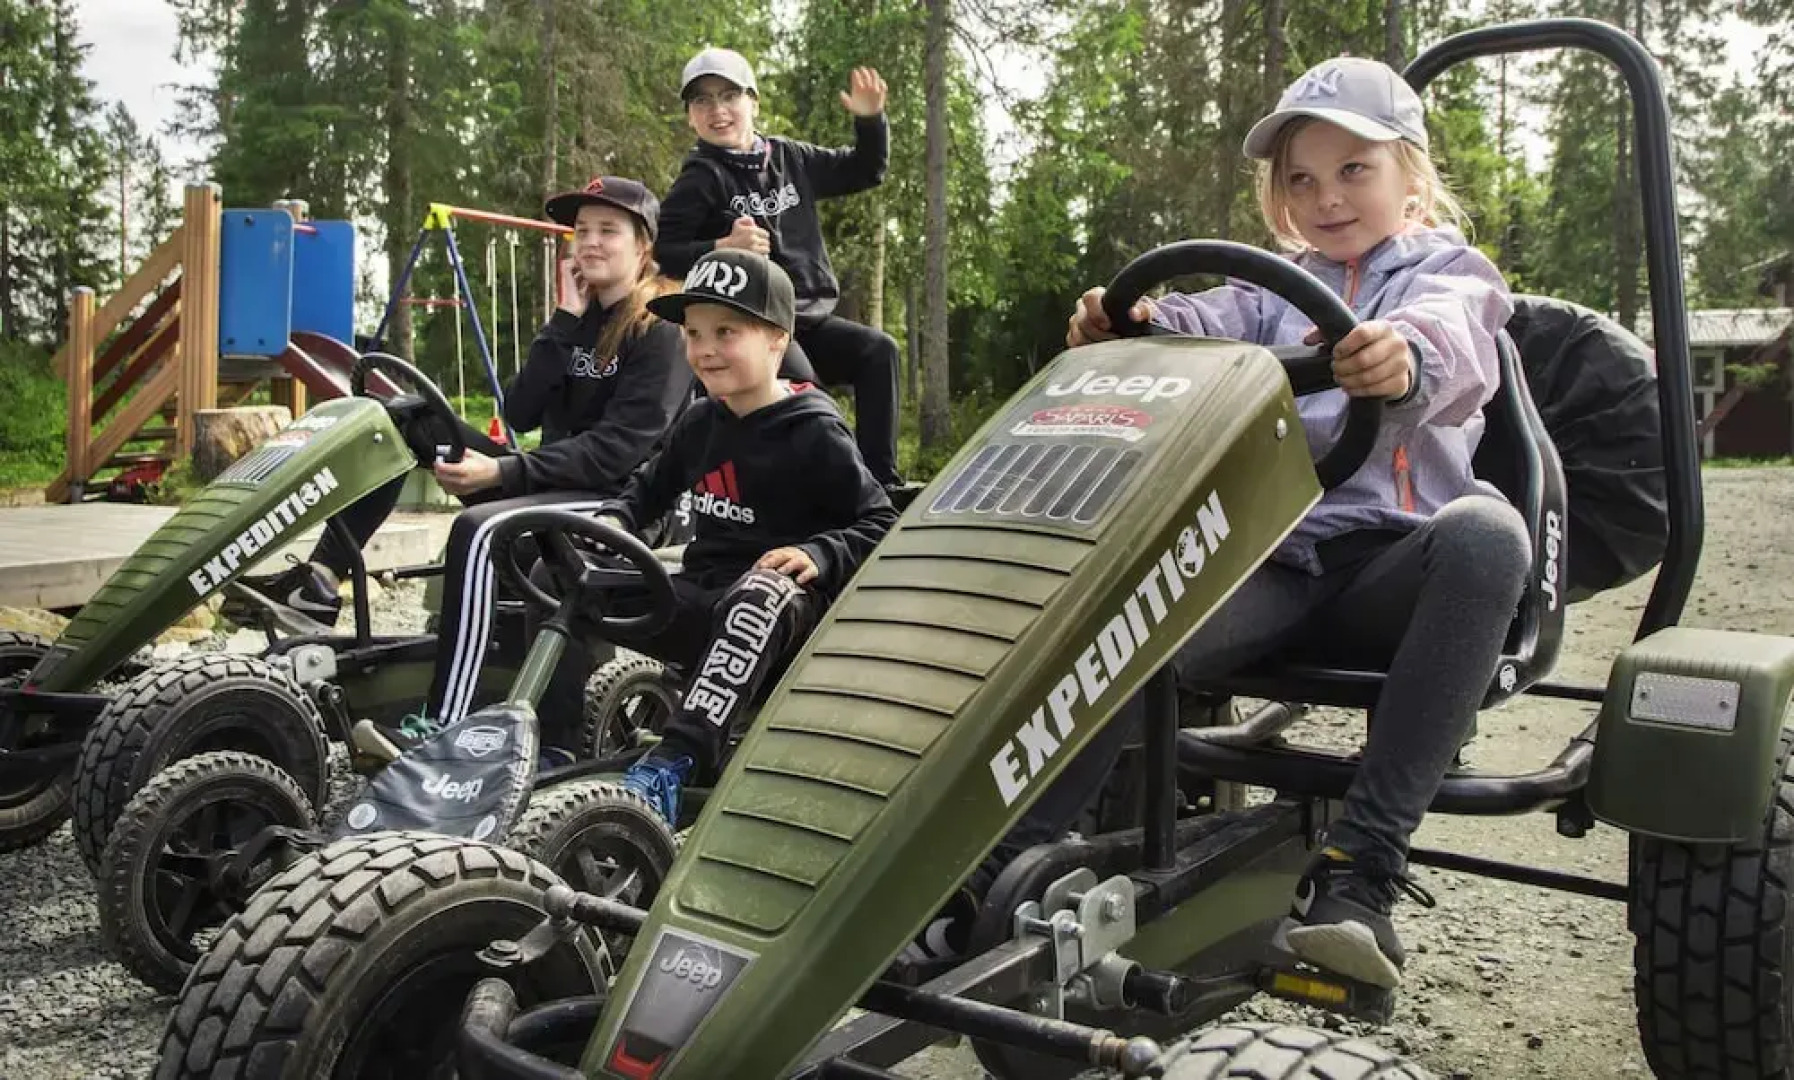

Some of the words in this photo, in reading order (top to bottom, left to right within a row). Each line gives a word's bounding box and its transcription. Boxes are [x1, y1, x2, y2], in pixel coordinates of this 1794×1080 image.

[1045, 369, 1192, 403] Jeep
[1540, 509, 1563, 613] Jeep
[420, 772, 484, 804] Jeep
[659, 947, 722, 992] Jeep
